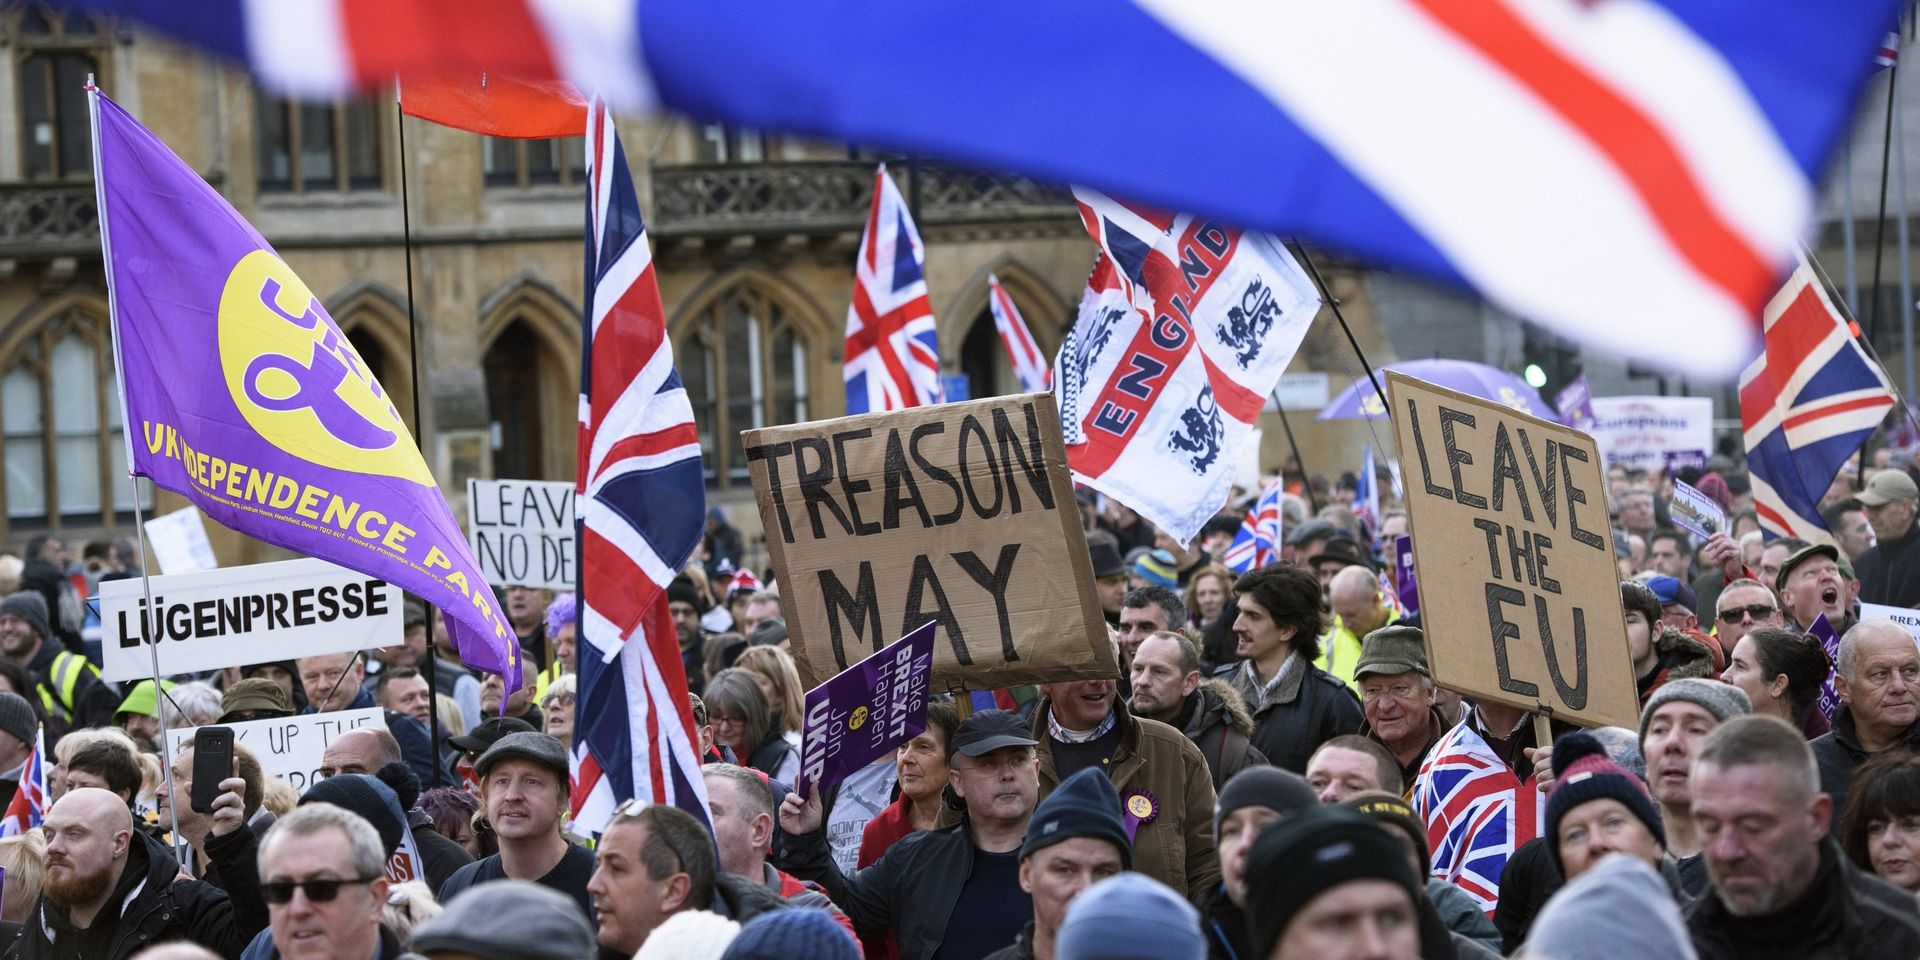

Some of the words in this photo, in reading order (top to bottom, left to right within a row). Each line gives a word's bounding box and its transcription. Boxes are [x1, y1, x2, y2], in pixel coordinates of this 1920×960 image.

[143, 420, 182, 461] UK
[745, 403, 1057, 544] TREASON
[1408, 398, 1605, 551] LEAVE
[472, 481, 576, 529] LEAV
[477, 531, 528, 581] NO
[1473, 517, 1562, 595] THE
[118, 580, 388, 648] LÜGENPRESSE
[817, 543, 1022, 672] MAY
[908, 652, 929, 714] Make
[1485, 582, 1589, 711] EU
[870, 660, 893, 750] Happen
[889, 644, 913, 741] BREXIT
[269, 724, 299, 755] UP
[803, 698, 830, 783] UKIP
[827, 708, 848, 758] Join
[830, 819, 869, 837] DON'T
